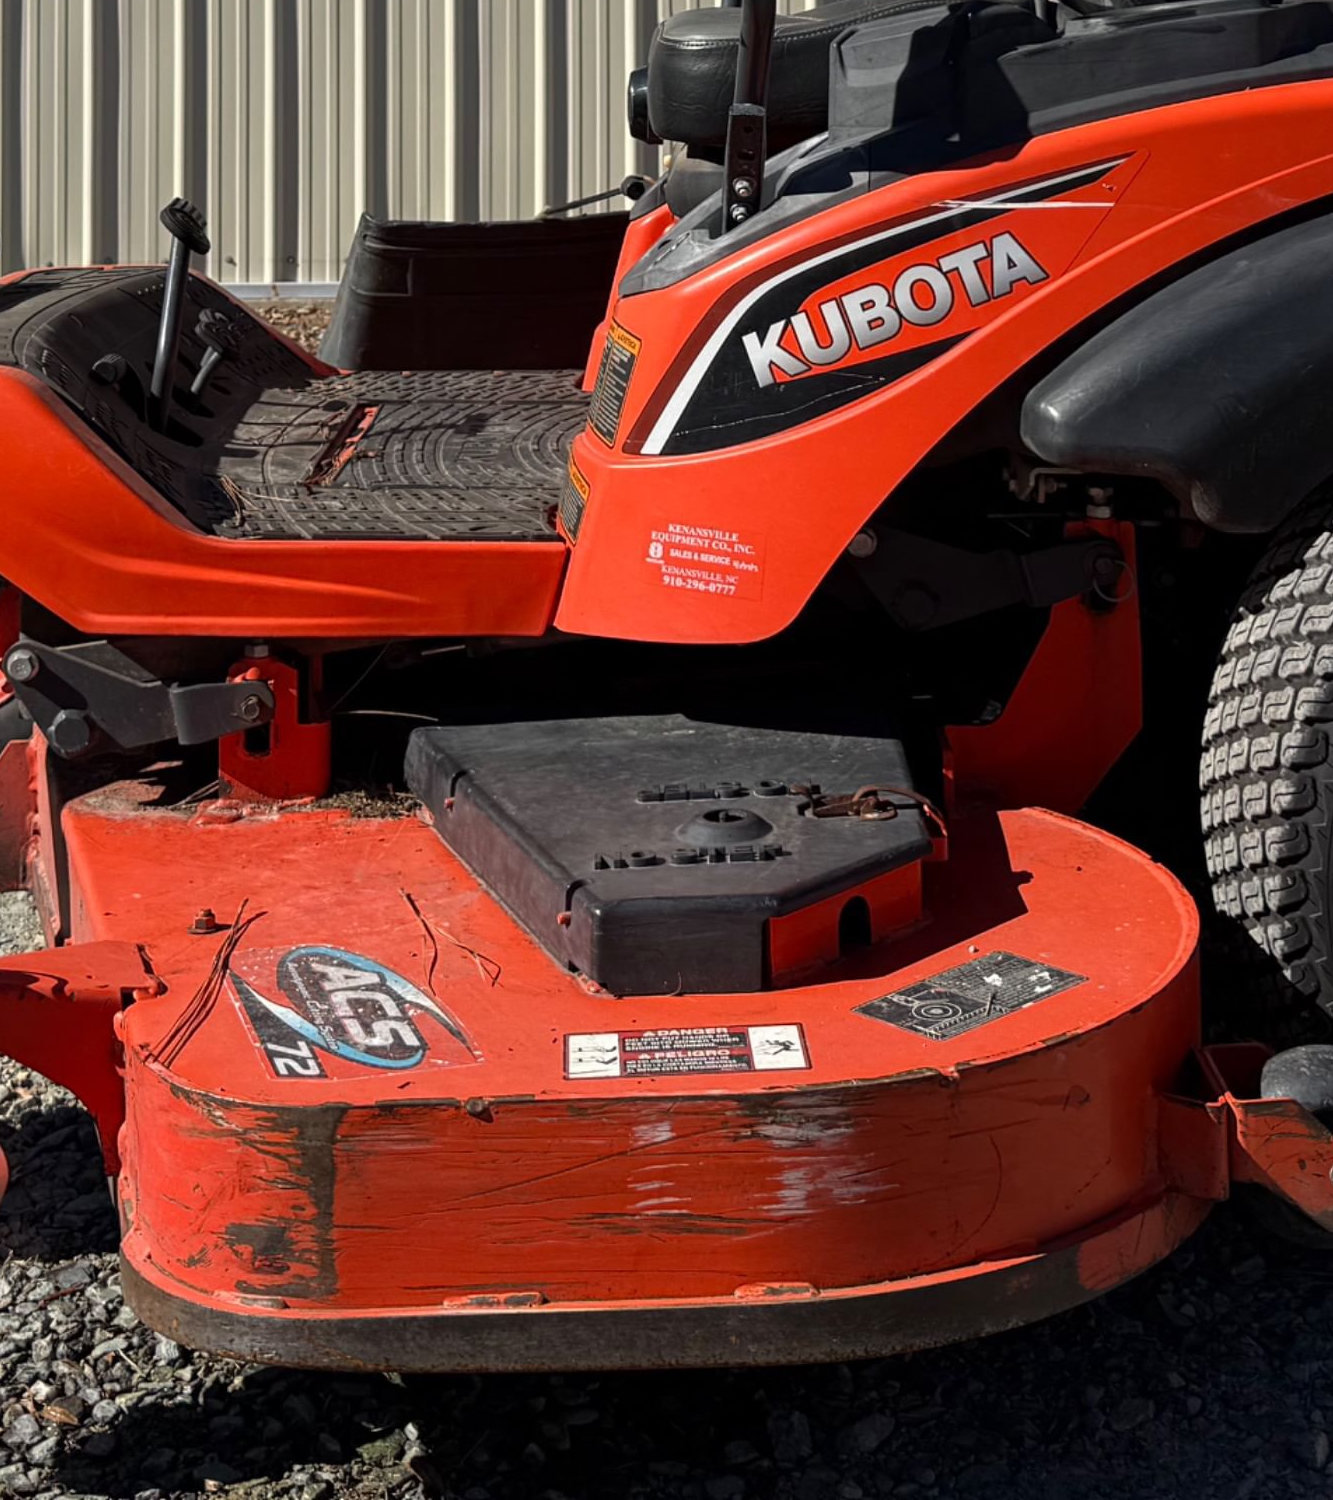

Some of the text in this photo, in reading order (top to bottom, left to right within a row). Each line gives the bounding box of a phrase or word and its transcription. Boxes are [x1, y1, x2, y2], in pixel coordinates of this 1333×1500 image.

[740, 231, 1050, 387] KUBOTA
[668, 523, 740, 542] KENANSVILLE
[651, 531, 710, 548] EQUIPMENT
[733, 543, 756, 555] INC.
[670, 548, 693, 560] SALES
[700, 553, 731, 565] SERVICE
[663, 575, 735, 595] 910-296-0777
[726, 574, 739, 583] NC
[310, 961, 422, 1049] ACS
[657, 1027, 728, 1037] DANGER
[268, 1040, 321, 1077] 72
[654, 1049, 731, 1060] PELIGRO
